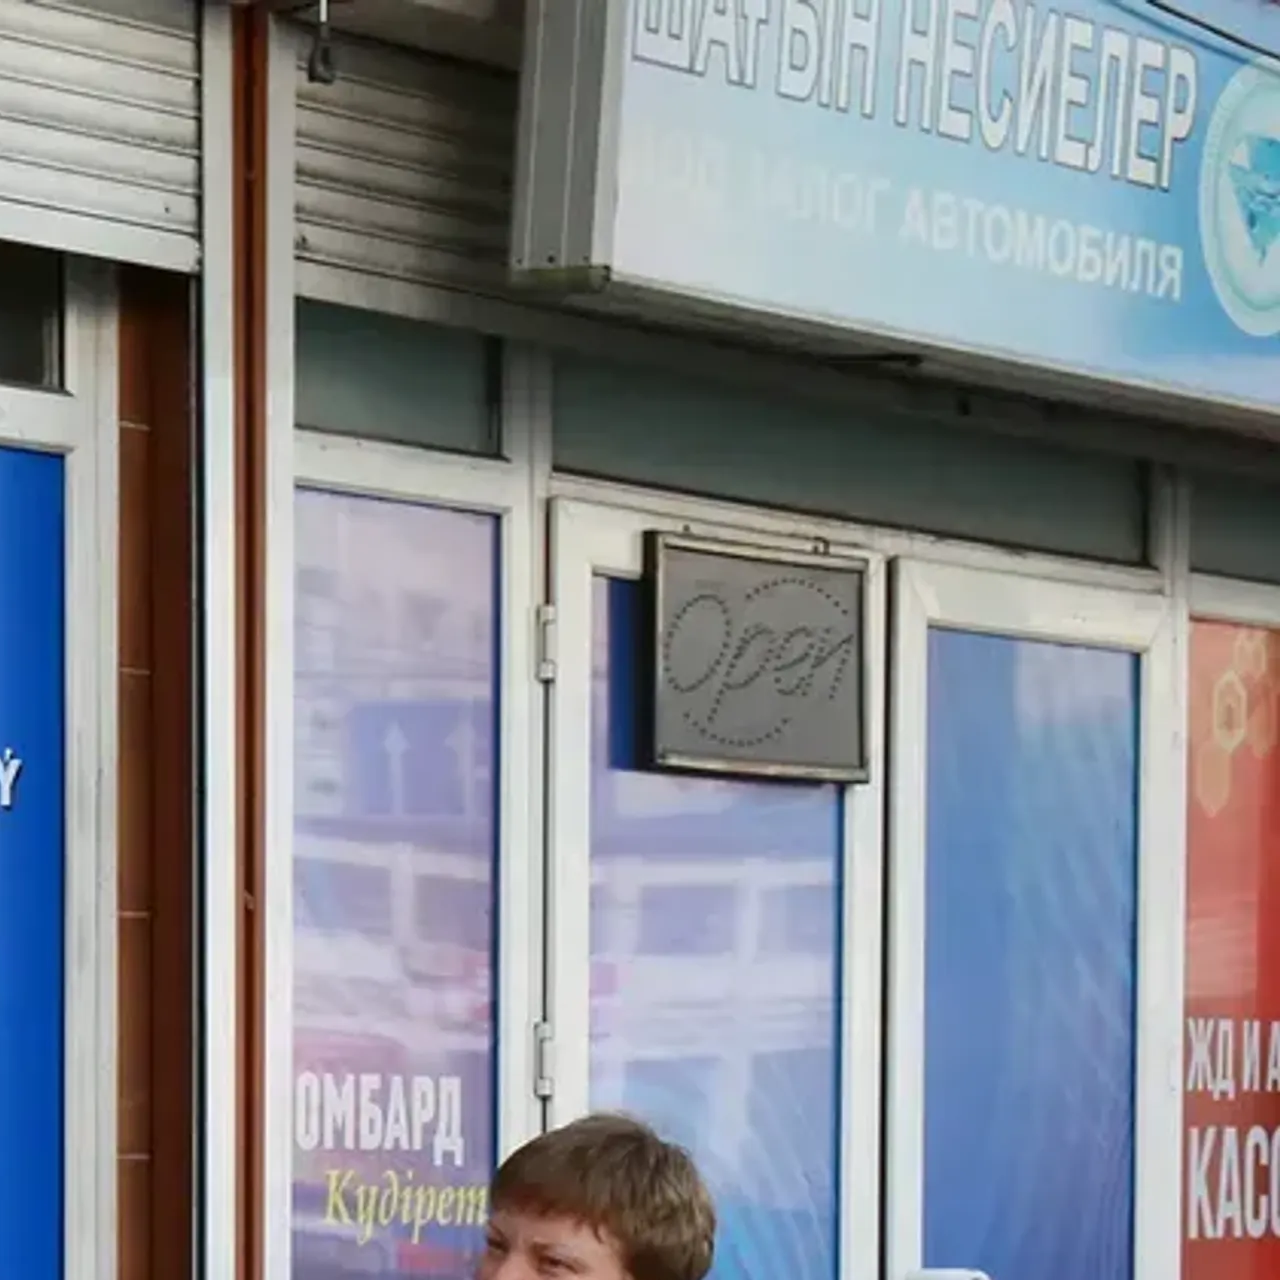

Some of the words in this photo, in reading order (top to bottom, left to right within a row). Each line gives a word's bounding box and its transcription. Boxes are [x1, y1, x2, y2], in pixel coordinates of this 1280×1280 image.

[894, 0, 1198, 192] НЕСИЕЛЕР
[900, 187, 1184, 302] АВТОМОБИЛЯ
[662, 592, 856, 725] Open
[1186, 1016, 1236, 1101] ЖД
[1242, 1019, 1261, 1092] И
